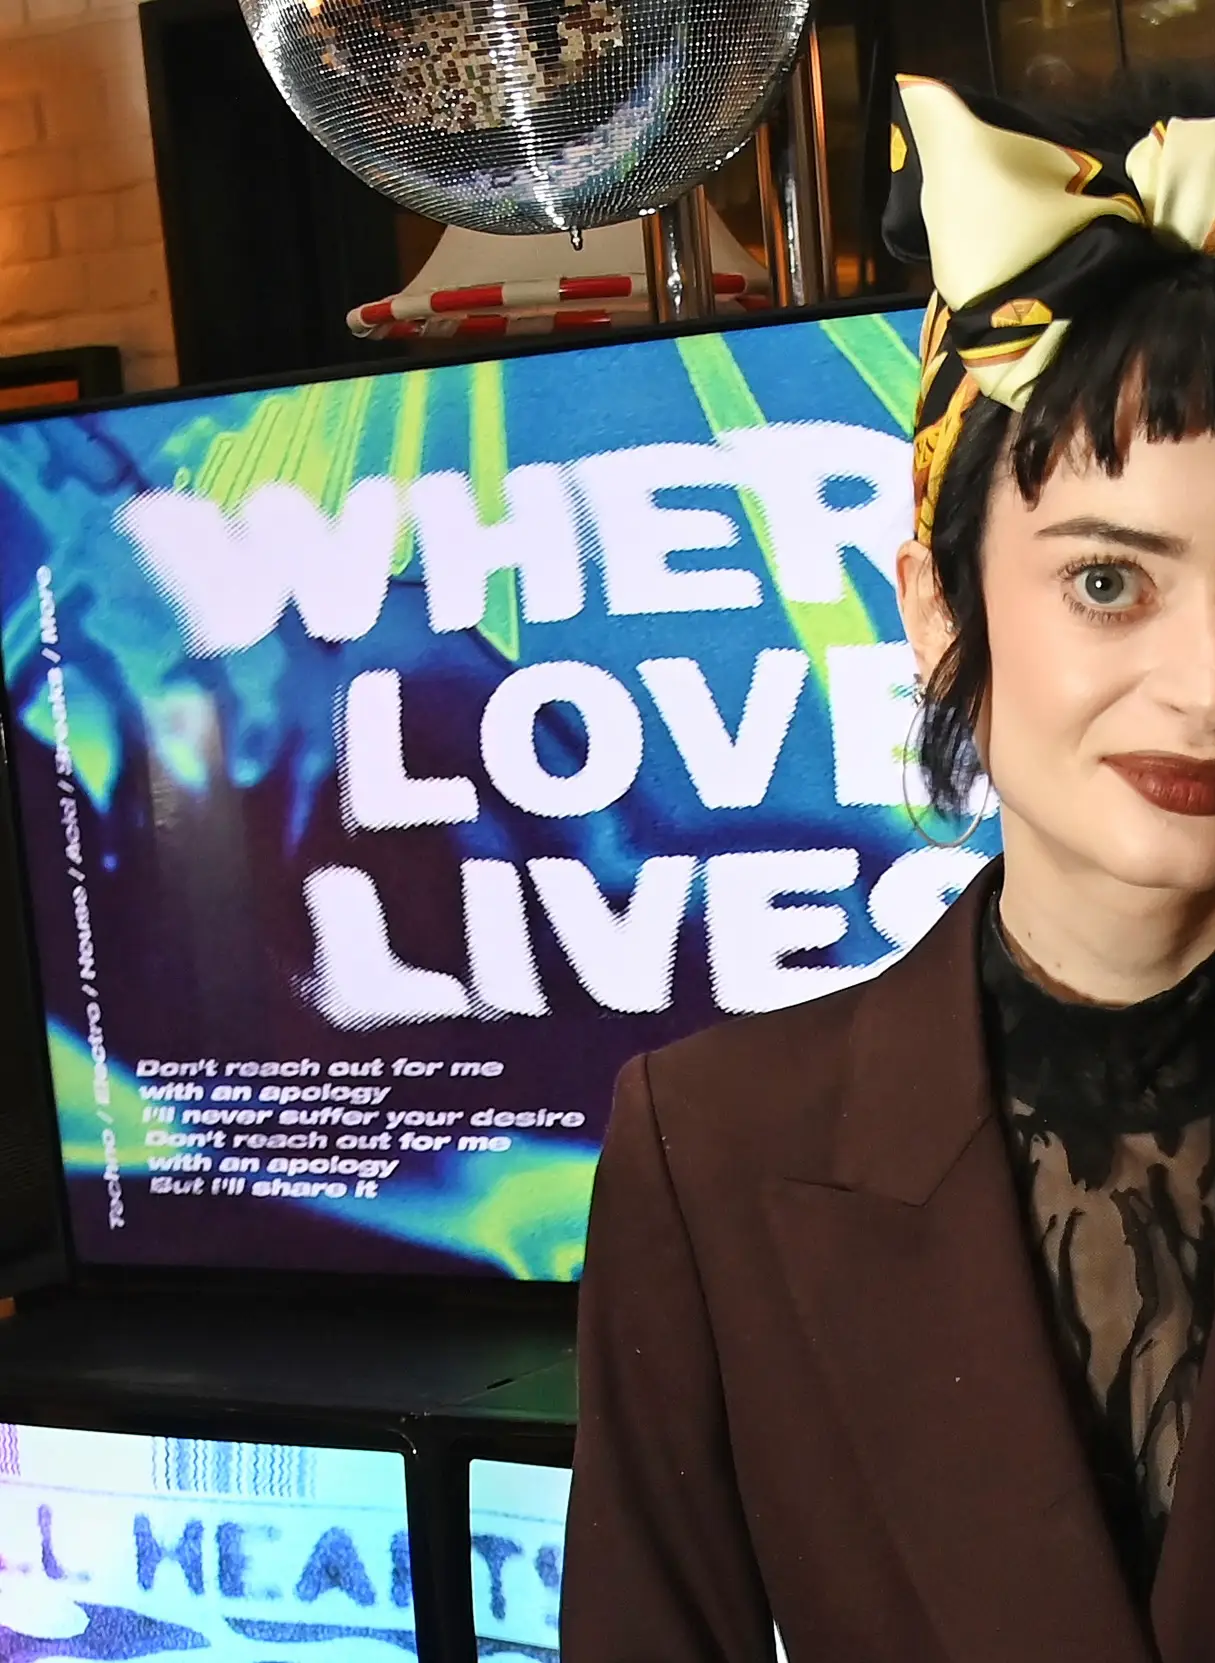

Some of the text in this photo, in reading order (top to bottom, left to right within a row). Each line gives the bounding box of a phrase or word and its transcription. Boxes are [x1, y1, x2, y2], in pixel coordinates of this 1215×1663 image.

[136, 1057, 504, 1078] Don't reach out for me
[138, 1082, 392, 1106] with an apology
[142, 1106, 586, 1130] I'll never suffer your desire
[144, 1130, 513, 1152] Don't reach out for me
[147, 1153, 400, 1179] with an apology
[150, 1176, 205, 1196] But
[251, 1178, 348, 1198] share
[354, 1179, 379, 1199] it
